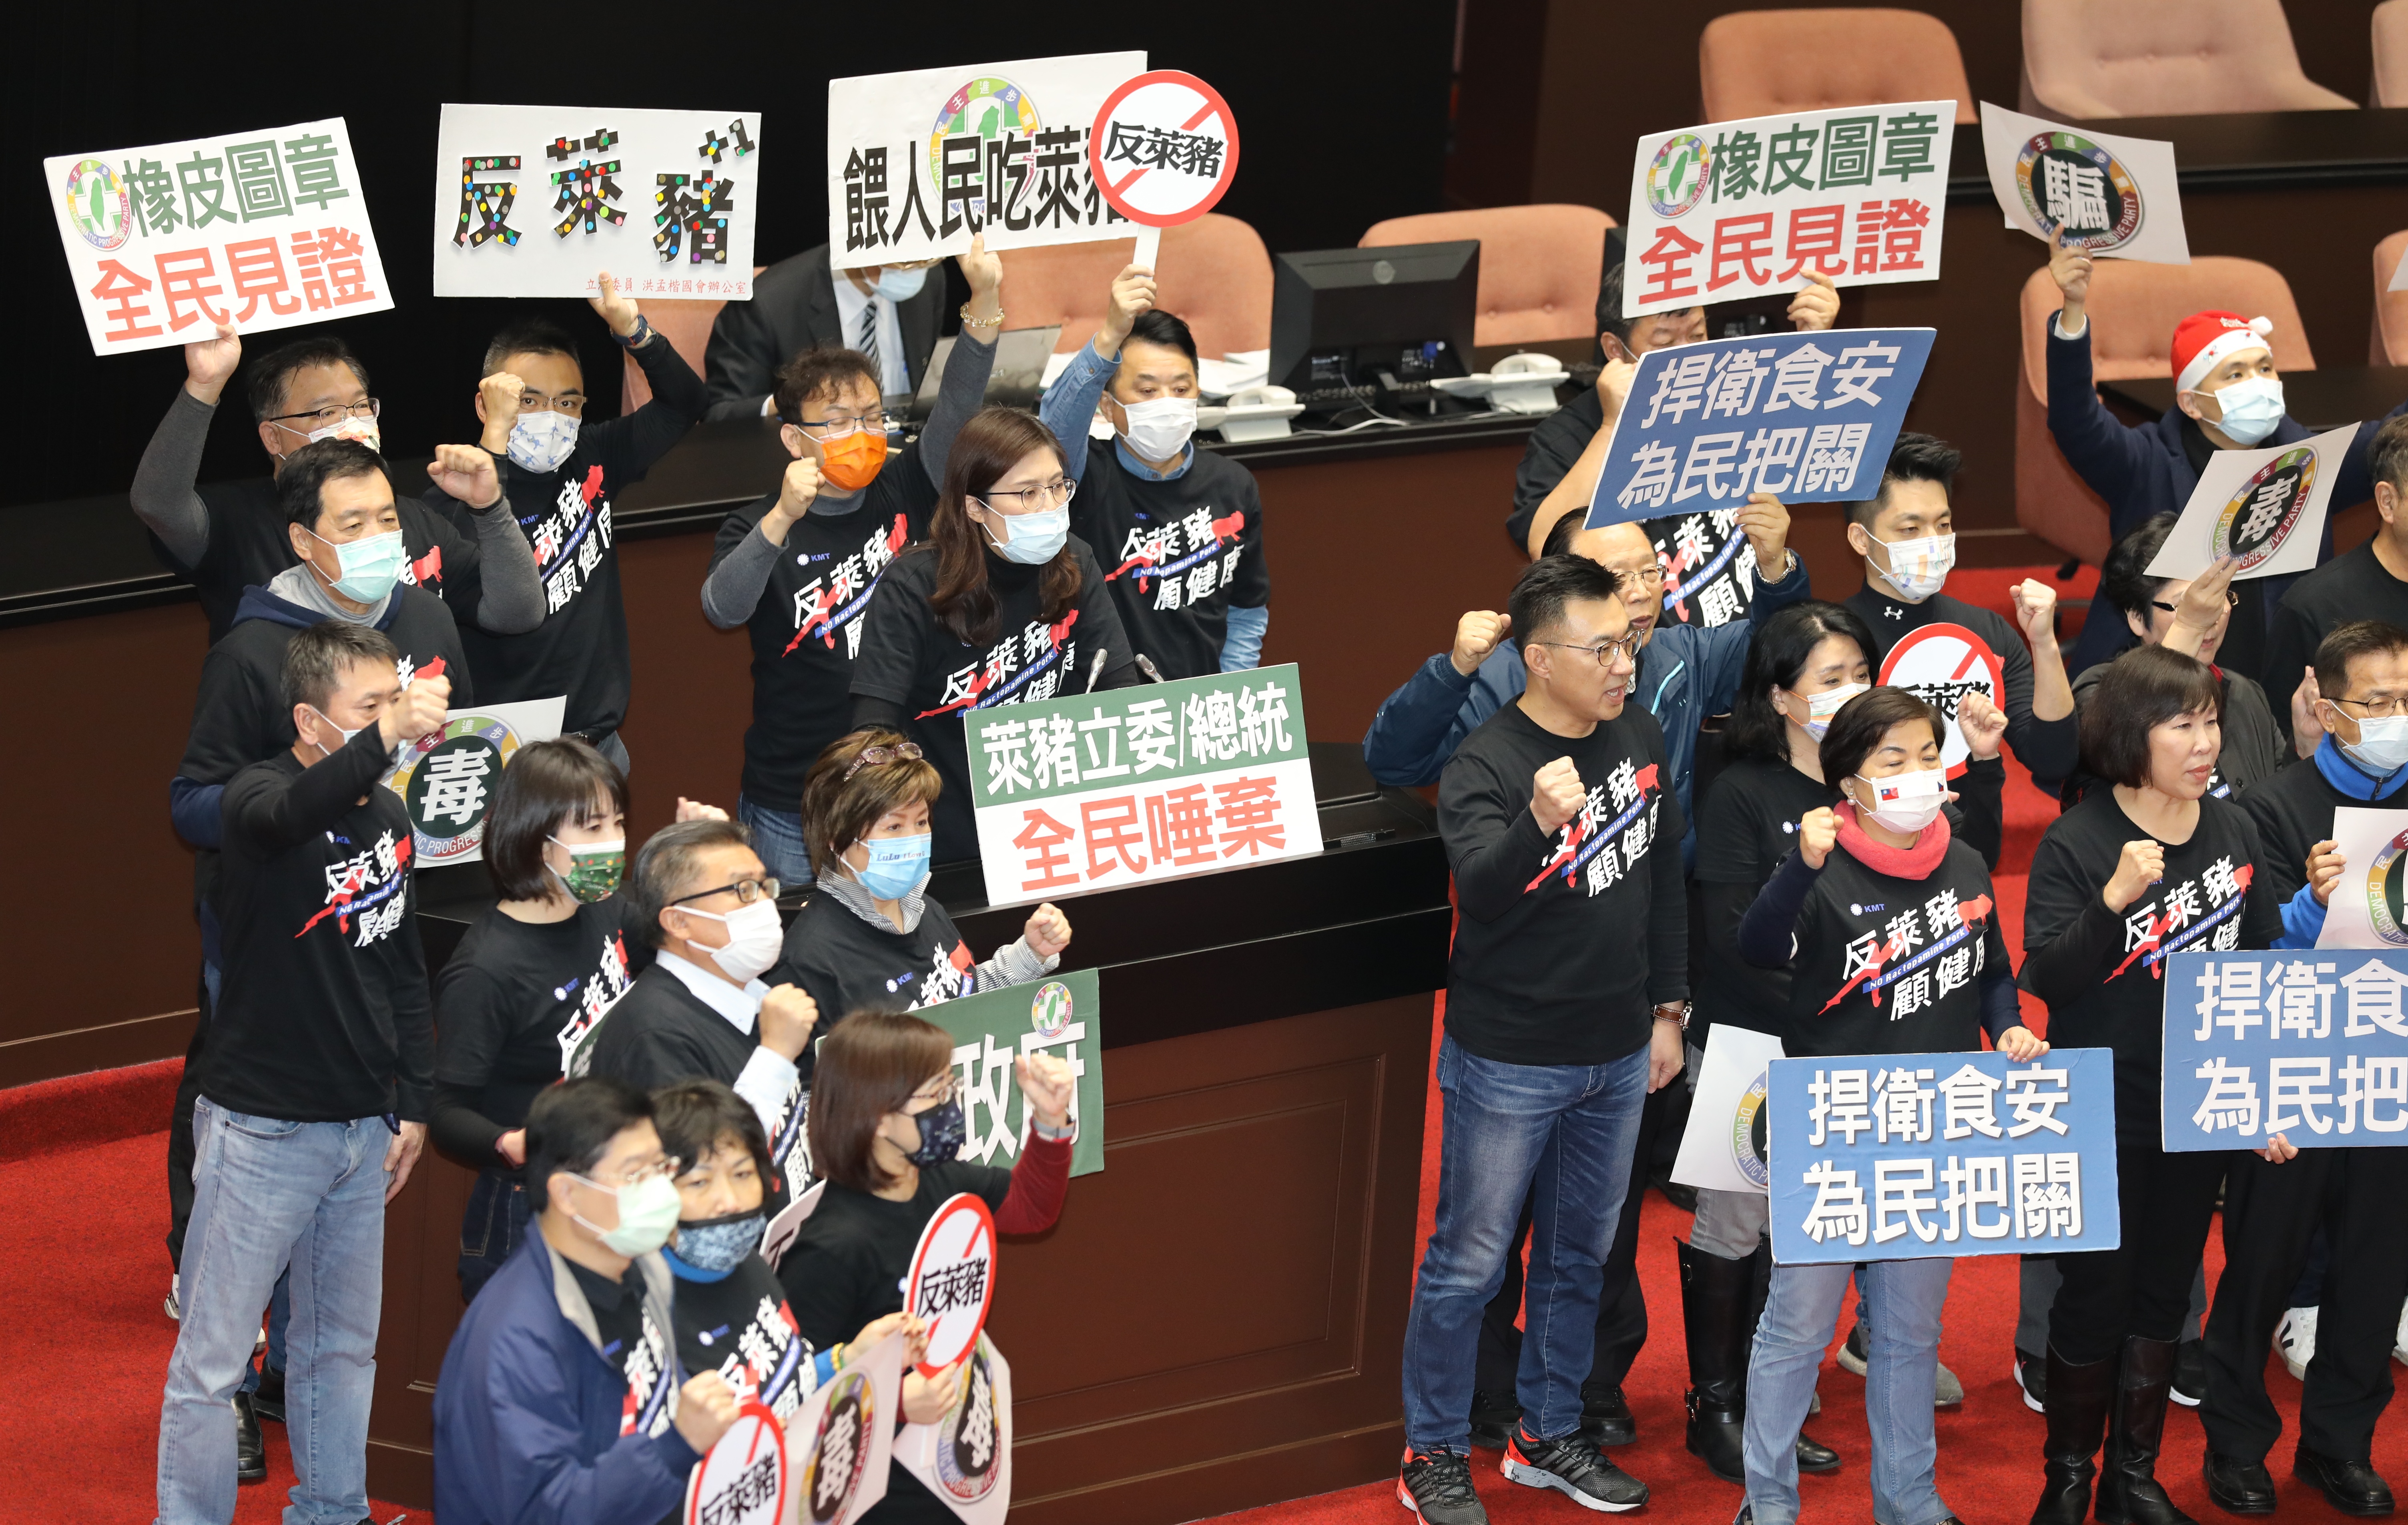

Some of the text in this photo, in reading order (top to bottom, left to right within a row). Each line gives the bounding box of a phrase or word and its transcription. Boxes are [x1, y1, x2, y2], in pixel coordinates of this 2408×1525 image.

[121, 134, 349, 237] 橡皮圖章
[1104, 121, 1224, 178] 反萊豬
[1700, 167, 1708, 190] PARTY
[1708, 112, 1938, 204] 橡皮圖章
[69, 197, 129, 247] DEMOCRATIC PROGRESSIVE PARTY
[451, 128, 734, 265] 反萊豬
[2018, 174, 2054, 234] DEMOCRATI
[2121, 197, 2137, 227] PARTY
[2043, 155, 2110, 231] 騙
[90, 226, 376, 342] 全民見證
[586, 278, 746, 294] 立委員 洪孟楷國會辦公室
[1638, 198, 1930, 305] 全民見證
[1640, 340, 1902, 429] 捍衛食安
[1616, 423, 1873, 510] 為民把關
[533, 478, 587, 565] 萊豬
[579, 515, 591, 534] Pork
[1120, 506, 1216, 565] 反萊豬
[2215, 492, 2306, 566] DEMOCR OGRESSIVE PARTY
[2237, 473, 2298, 544] 毒
[794, 524, 893, 629] 反萊豬
[811, 553, 830, 562] KMT
[1140, 568, 1152, 576] NO
[1199, 544, 1216, 558] Pork
[1671, 524, 1746, 603] NO Ractopamine Po
[1698, 543, 1756, 628] 顧健
[821, 580, 878, 634] NO Ractopamin
[940, 621, 1052, 705] 反萊豬
[980, 667, 1034, 708] Ractopamine
[1036, 651, 1053, 670] Pork
[1902, 681, 1990, 722] 萊豬
[981, 681, 1292, 796] 萊豬立委/總統
[420, 746, 492, 825] 毒
[324, 829, 399, 904] 反萊豬
[335, 836, 351, 845] KM
[426, 821, 487, 854] PROGRESS
[876, 853, 900, 861] LuLu
[1012, 776, 1286, 892] 全民唾棄
[1568, 800, 1642, 873] NO Ractopamine Pork
[339, 905, 353, 915] NO
[354, 891, 405, 947] 顧健
[1842, 888, 1962, 980] 反萊豬
[1864, 904, 1885, 913] KMT
[2125, 855, 2240, 952] 反萊豬
[2150, 951, 2161, 962] NO
[2165, 911, 2222, 953] Ractopamine
[2224, 895, 2240, 914] Pork
[897, 972, 914, 985] KMT
[907, 942, 961, 1011] 萊豬
[1870, 927, 1965, 989] NO Ractopamine Pork
[1890, 928, 1989, 1021] 顧健康
[2194, 959, 2408, 1041] 捍衛食
[1807, 1062, 2068, 1146] 捍衛食安
[2192, 1055, 2408, 1136] 為民把
[1736, 1107, 1761, 1176] DEMOCRATIC
[1801, 1152, 2081, 1246] 為民把關
[917, 1258, 987, 1318] 反萊豬
[817, 1403, 857, 1511] 毒
